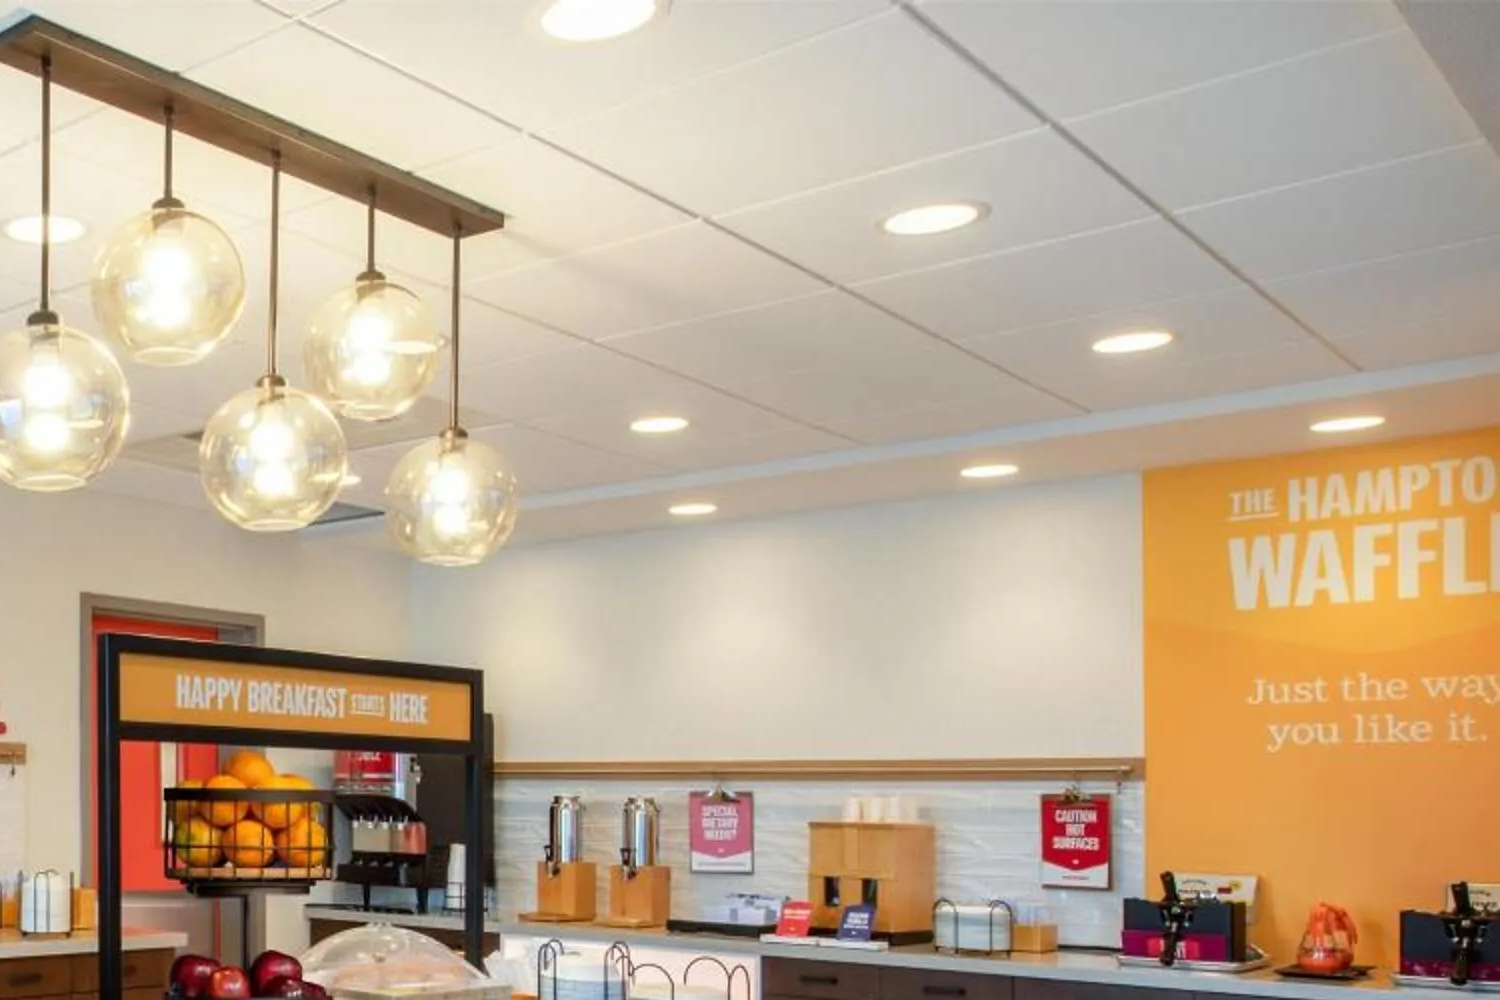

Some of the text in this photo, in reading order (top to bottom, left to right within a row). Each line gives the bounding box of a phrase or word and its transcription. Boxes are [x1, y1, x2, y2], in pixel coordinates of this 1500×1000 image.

[1229, 487, 1276, 516] THE
[1227, 512, 1500, 611] WAFFL
[176, 673, 242, 711] HAPPY
[248, 679, 346, 718] BREAKFAST
[389, 692, 428, 724] HERE
[1247, 672, 1500, 705] Just the way
[1266, 711, 1488, 753] you like it.
[702, 805, 737, 817] SPECIAL
[1055, 809, 1097, 824] CAUTION
[1052, 836, 1100, 851] SURFACES
[1065, 823, 1085, 837] HOT
